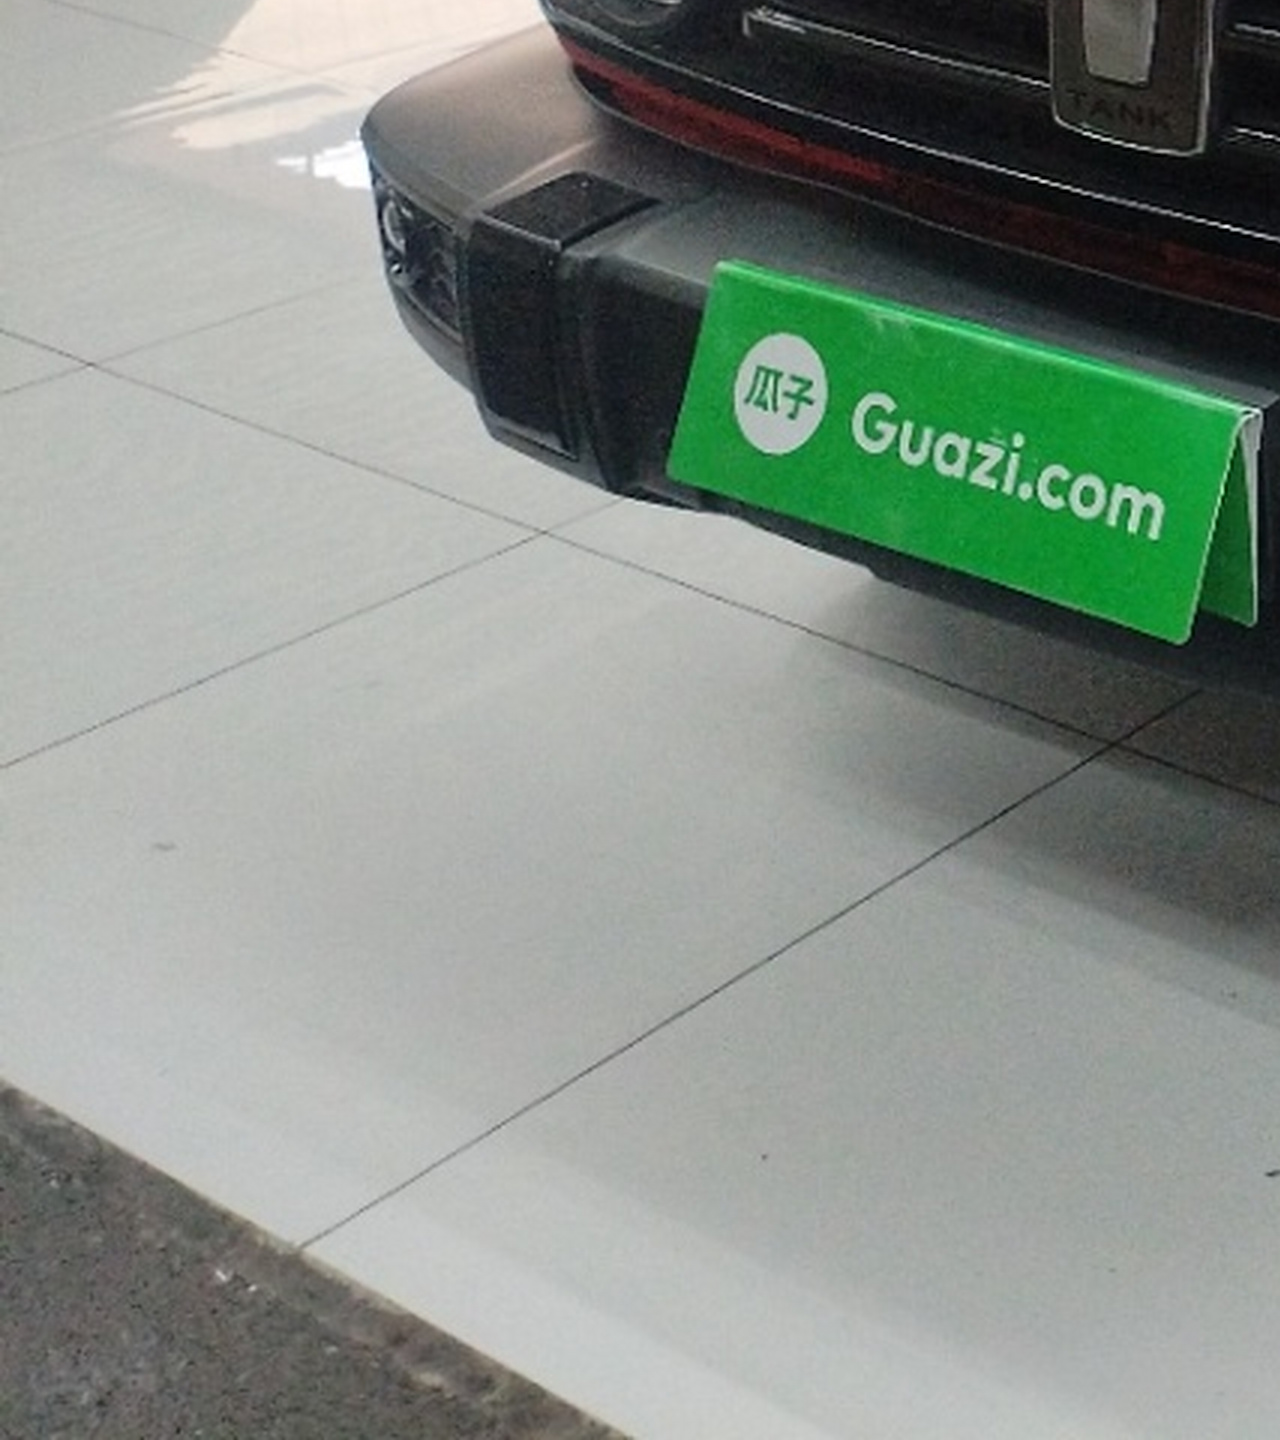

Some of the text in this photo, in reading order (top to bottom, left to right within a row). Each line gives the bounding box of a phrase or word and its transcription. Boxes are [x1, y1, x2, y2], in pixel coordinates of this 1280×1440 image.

[1067, 90, 1173, 132] TANK
[744, 366, 815, 420] 瓜子
[850, 391, 1166, 541] Guazi.com
